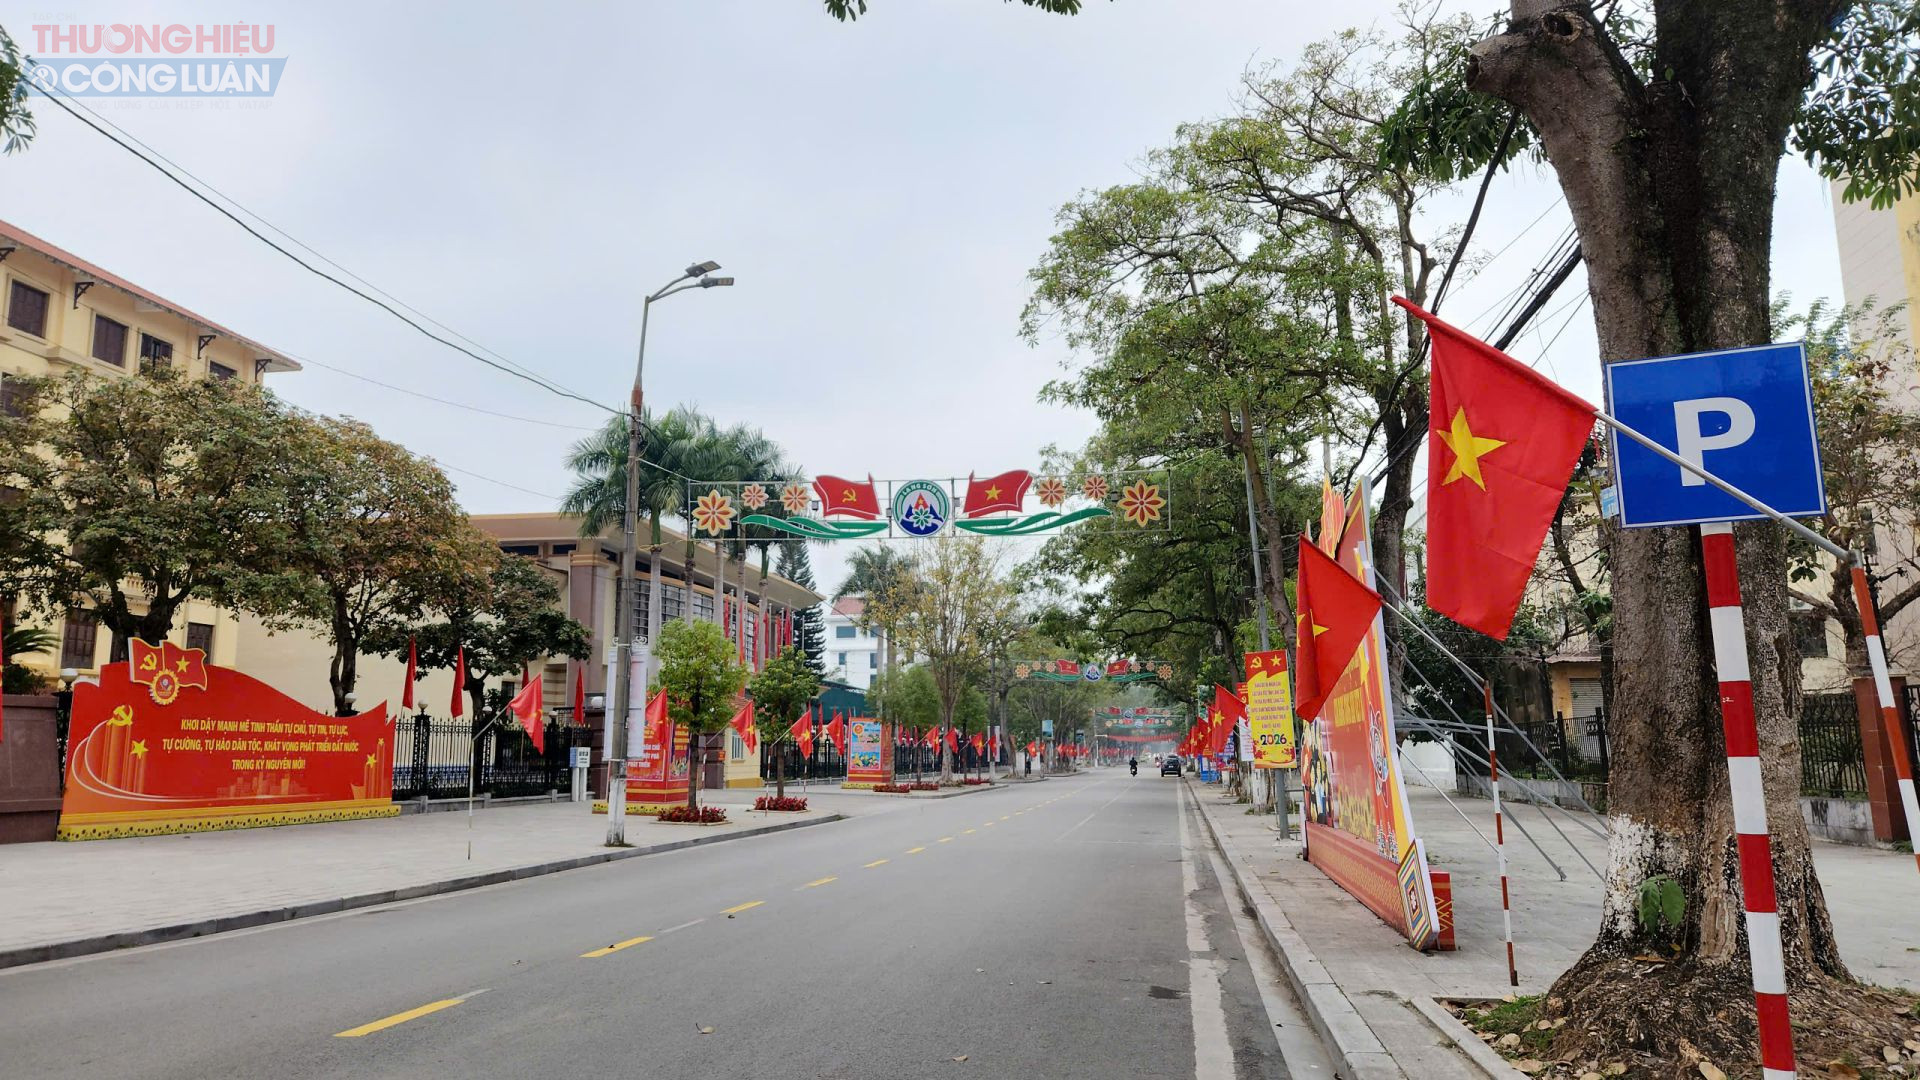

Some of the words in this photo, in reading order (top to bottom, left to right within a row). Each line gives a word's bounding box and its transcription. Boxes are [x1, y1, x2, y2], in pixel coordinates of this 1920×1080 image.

[1673, 397, 1756, 487] P
[217, 720, 239, 735] MẠNH
[250, 721, 266, 733] TINH
[284, 722, 293, 737] TỰ
[308, 724, 318, 737] TỰ
[328, 724, 337, 738] TỰ
[162, 736, 174, 754] TỰ
[205, 738, 216, 755] TỰ
[231, 737, 247, 751] DÂN
[263, 738, 281, 752] KHÁT
[281, 741, 299, 755] VỌNG
[299, 739, 315, 752] PHÁT
[1260, 733, 1287, 746] 2026
[231, 759, 255, 770] TRONG
[265, 756, 292, 770] NGUYÊN
